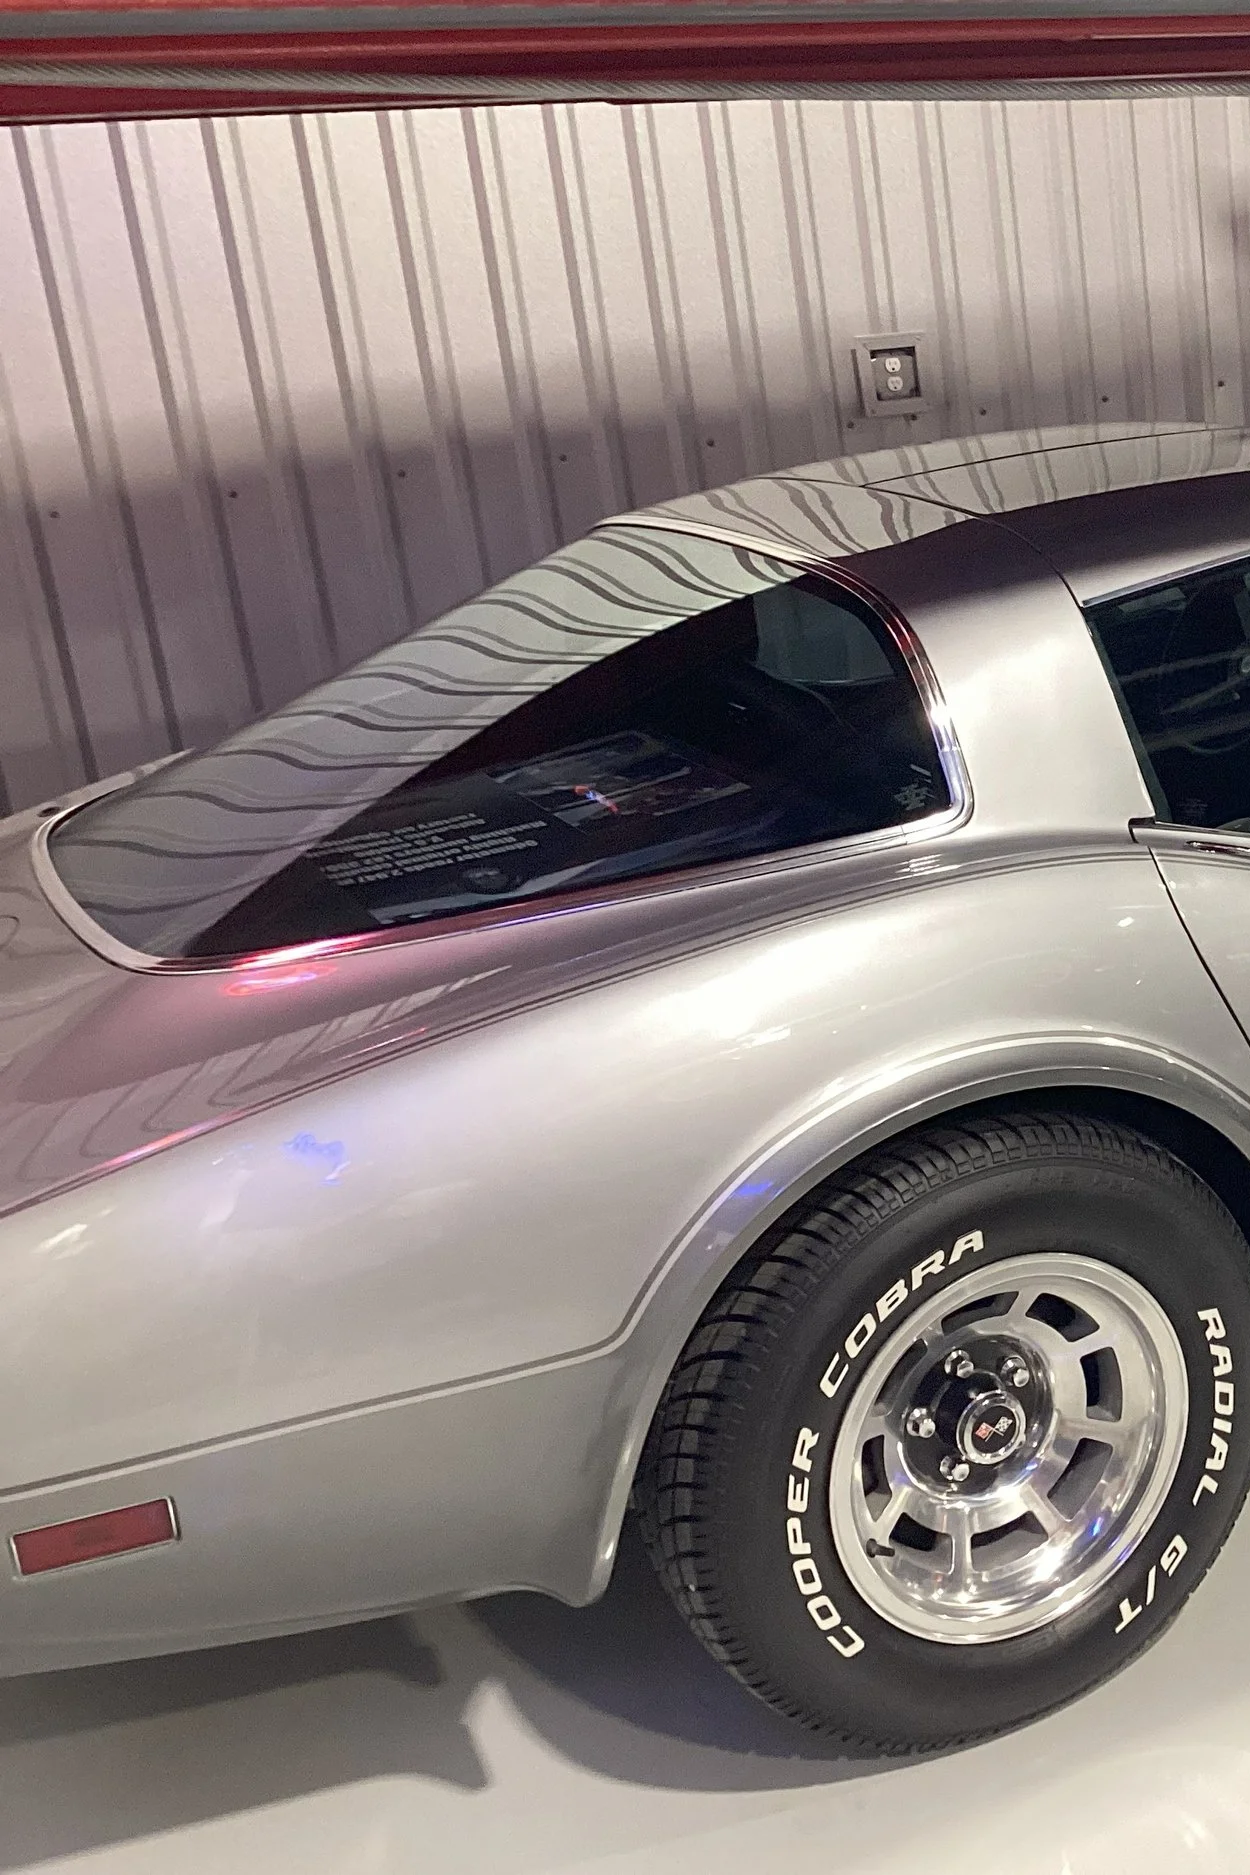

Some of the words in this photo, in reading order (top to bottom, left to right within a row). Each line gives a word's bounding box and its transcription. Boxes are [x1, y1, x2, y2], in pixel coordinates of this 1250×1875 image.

[819, 1230, 985, 1399] COBRA
[1192, 1307, 1235, 1506] RADIAL
[786, 1427, 866, 1658] COOPER
[1113, 1534, 1188, 1634] G/T
